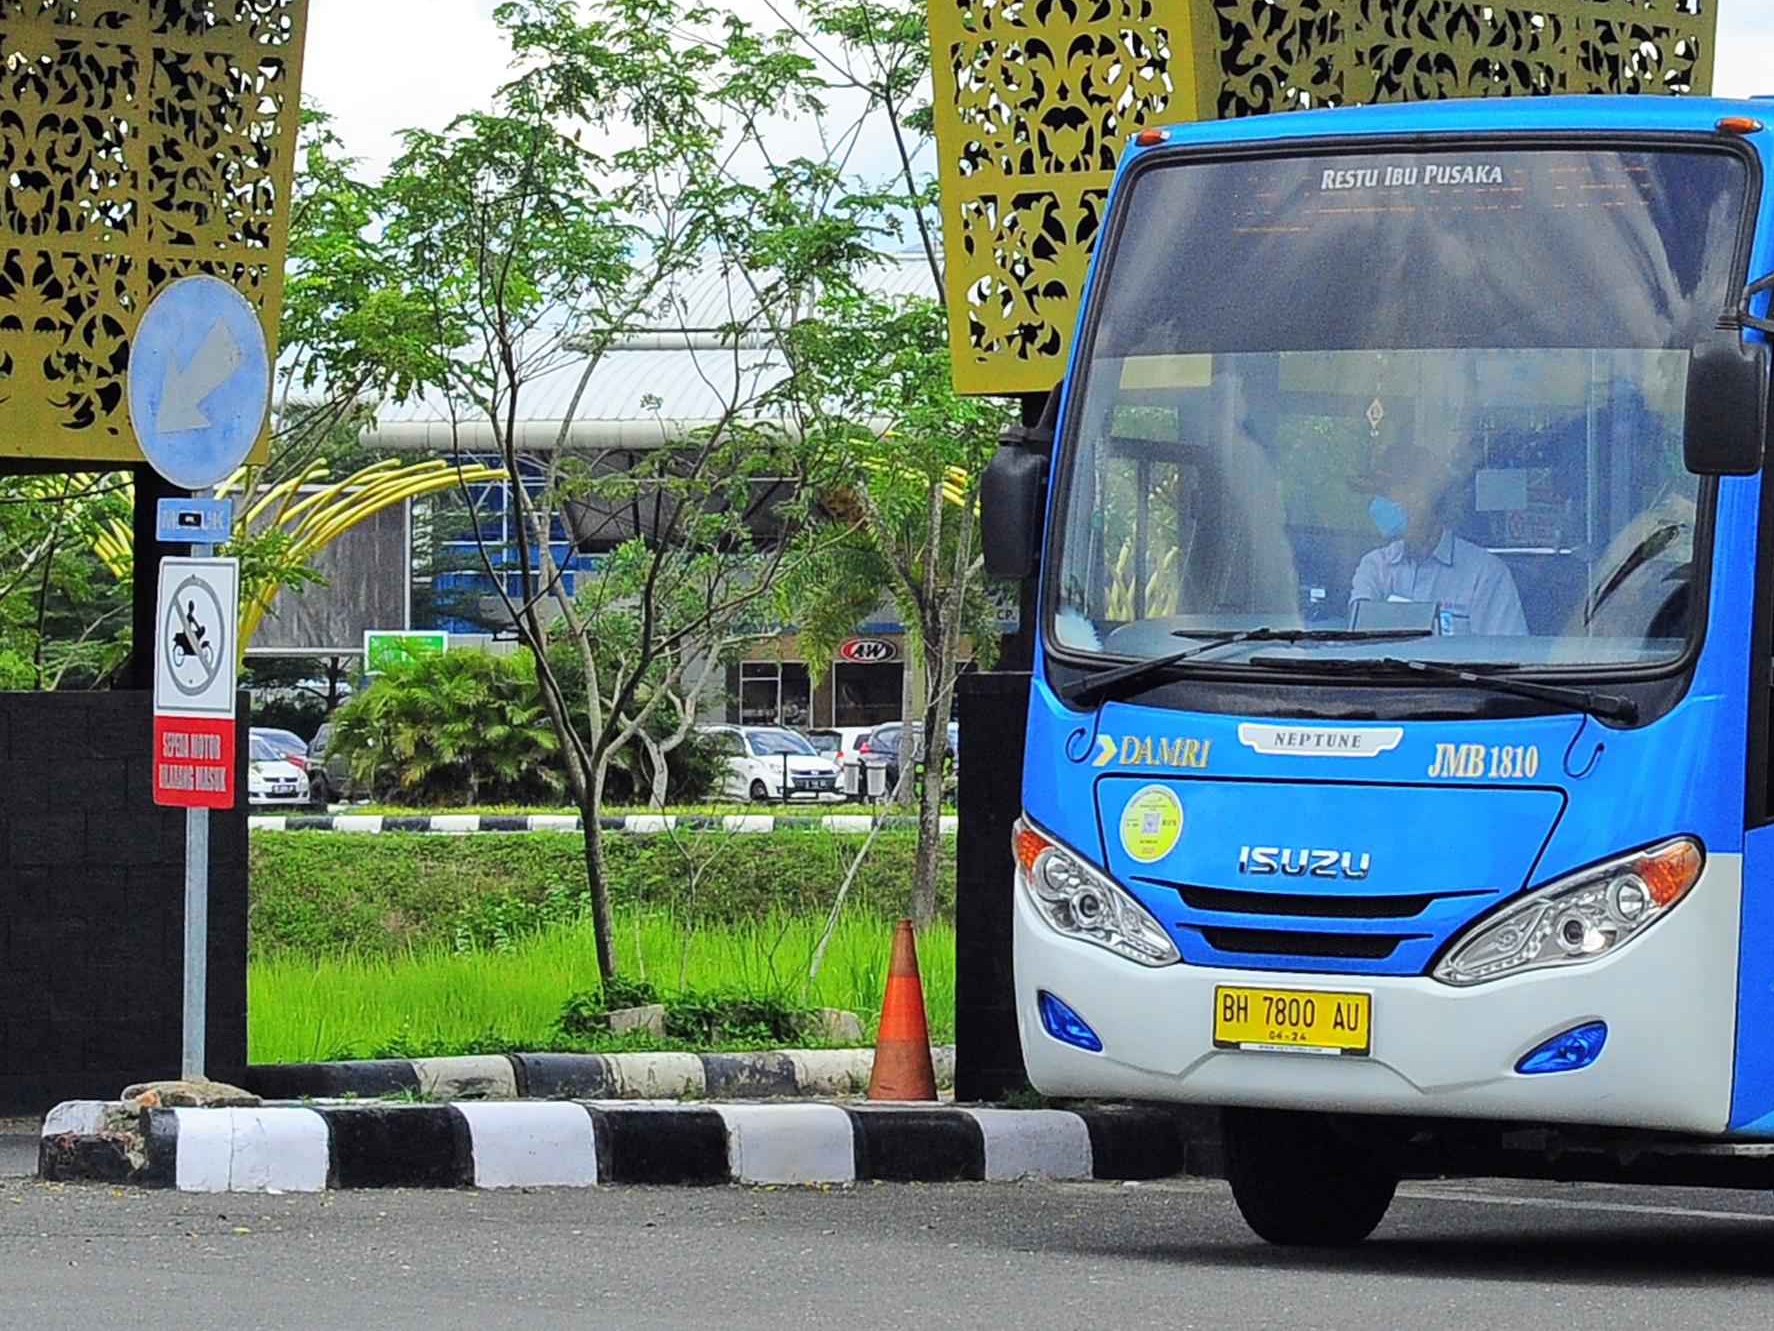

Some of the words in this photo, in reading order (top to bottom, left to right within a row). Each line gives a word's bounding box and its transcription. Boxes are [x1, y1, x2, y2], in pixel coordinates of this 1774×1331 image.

[1321, 169, 1378, 190] RESTU
[1384, 166, 1419, 186] IBU
[1423, 164, 1503, 185] PUSAKA
[1118, 735, 1211, 768] DAMRI
[1274, 732, 1362, 748] NEPTUNE
[1428, 743, 1486, 777] JMB
[1488, 745, 1539, 778] 1810
[1239, 845, 1371, 880] ISUZU
[1223, 994, 1249, 1023] BH
[1263, 996, 1315, 1027] 7800
[1333, 1002, 1359, 1031] AU
[1269, 1031, 1307, 1041] 04-24
